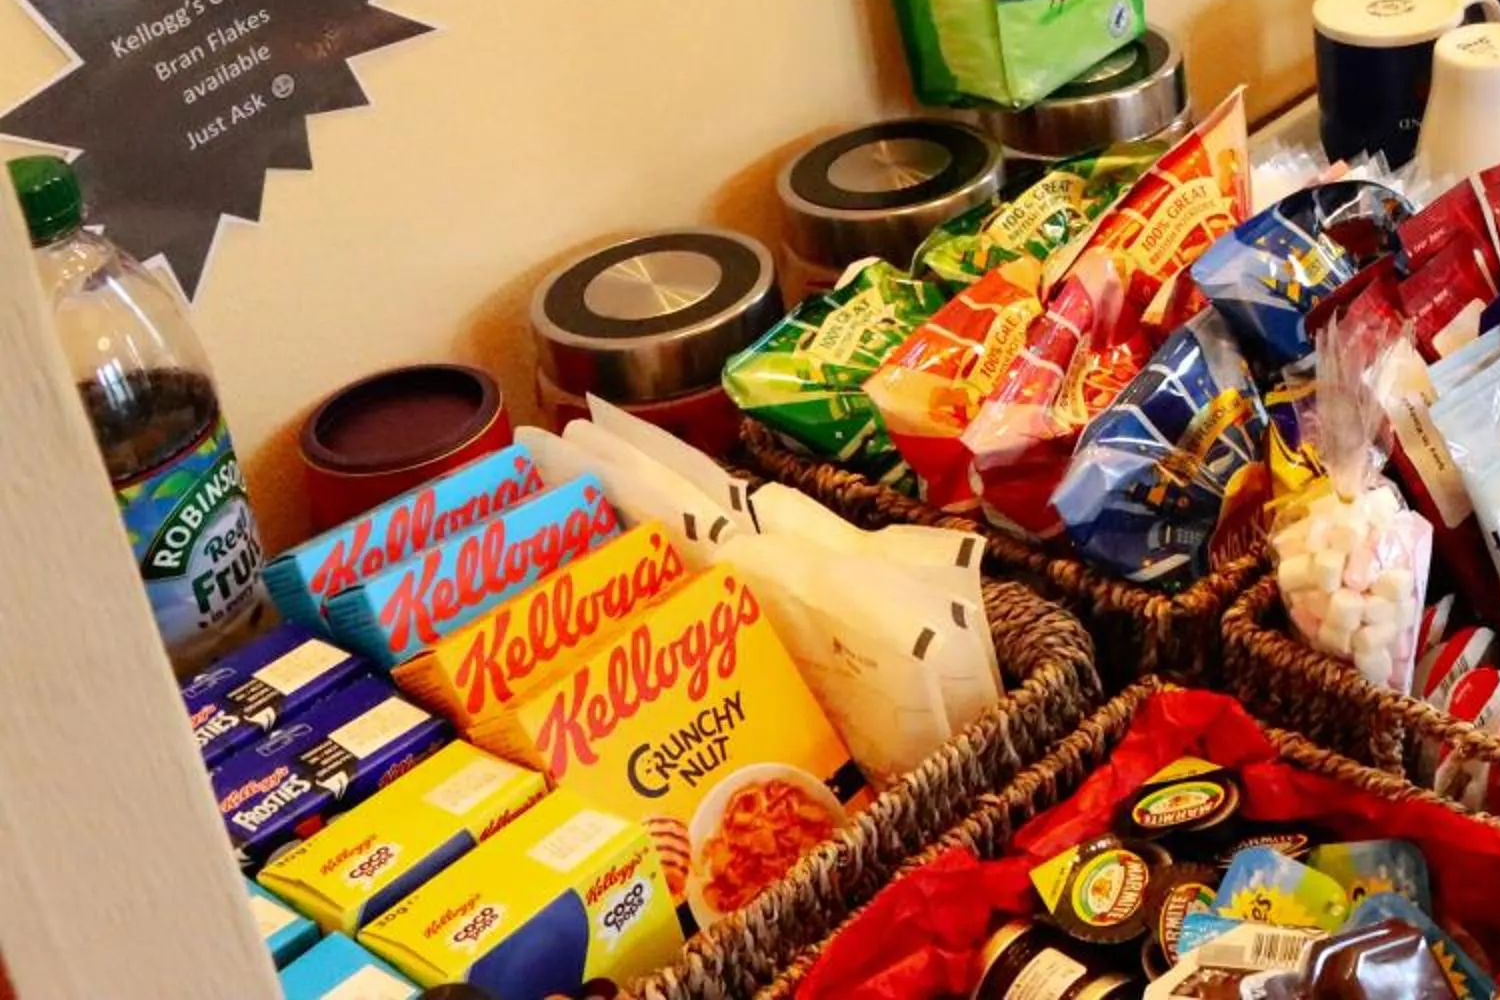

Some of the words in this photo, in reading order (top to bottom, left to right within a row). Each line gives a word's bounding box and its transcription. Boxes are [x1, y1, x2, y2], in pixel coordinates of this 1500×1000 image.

[111, 0, 205, 59] Kellogg's
[155, 44, 204, 82] Bran
[207, 8, 272, 55] Flakes
[182, 44, 272, 105] available
[187, 116, 227, 151] Just
[231, 93, 268, 124] Ask
[1166, 185, 1207, 219] GREAT
[378, 486, 620, 653] Kellogg's
[456, 533, 685, 714] Kellogg's
[534, 576, 760, 782] Kellogg's
[627, 691, 746, 798] CRUNCHY
[679, 735, 730, 787] NUT
[232, 773, 312, 832] FROSTIES
[349, 846, 390, 878] COCO
[1107, 857, 1146, 920] MARMITE
[453, 907, 494, 942] COCO
[604, 883, 643, 927] COCO
